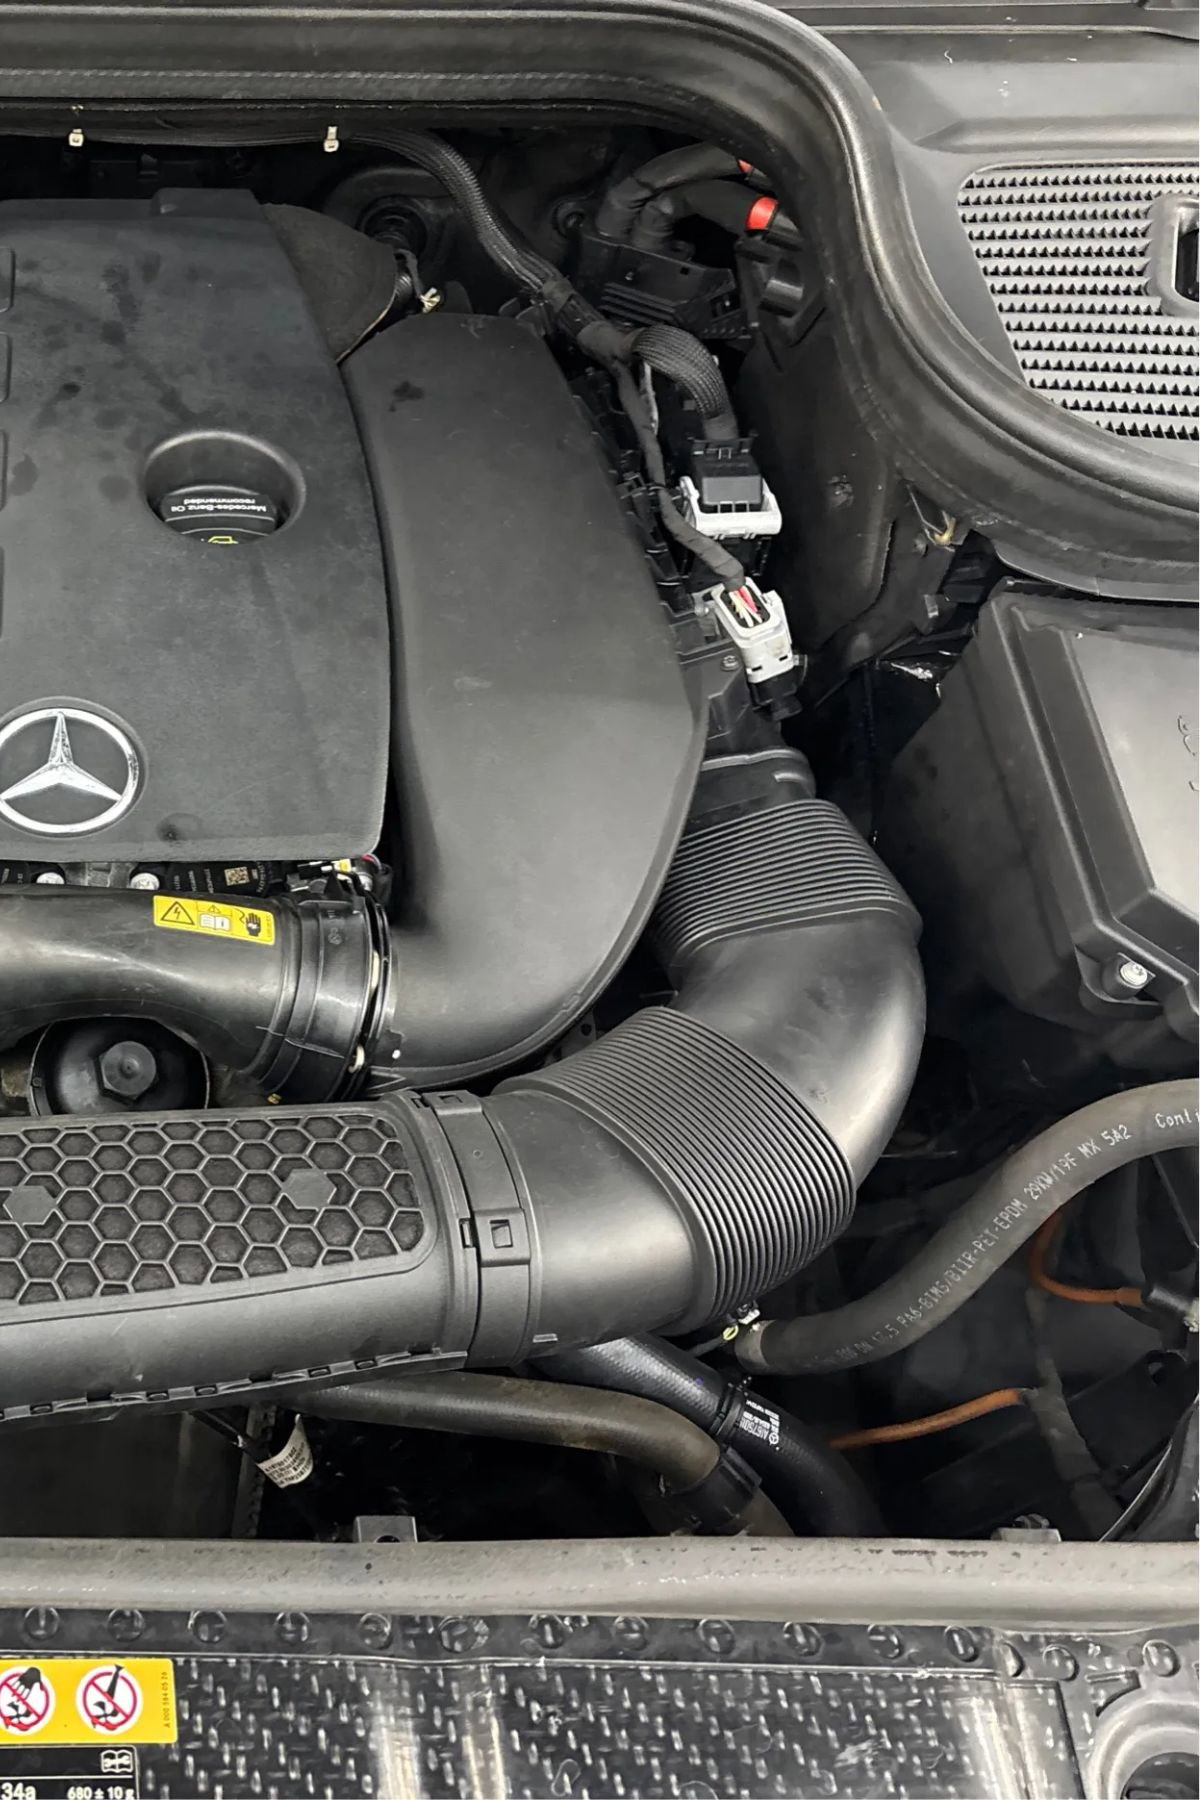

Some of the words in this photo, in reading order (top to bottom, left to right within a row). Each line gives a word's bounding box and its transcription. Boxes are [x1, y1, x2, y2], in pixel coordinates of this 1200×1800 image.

[187, 504, 267, 512] Mercedes-Benz
[1078, 1140, 1102, 1159] MX
[1102, 1124, 1131, 1146] 5A2
[67, 1786, 93, 1799] 680
[108, 1786, 123, 1799] 10
